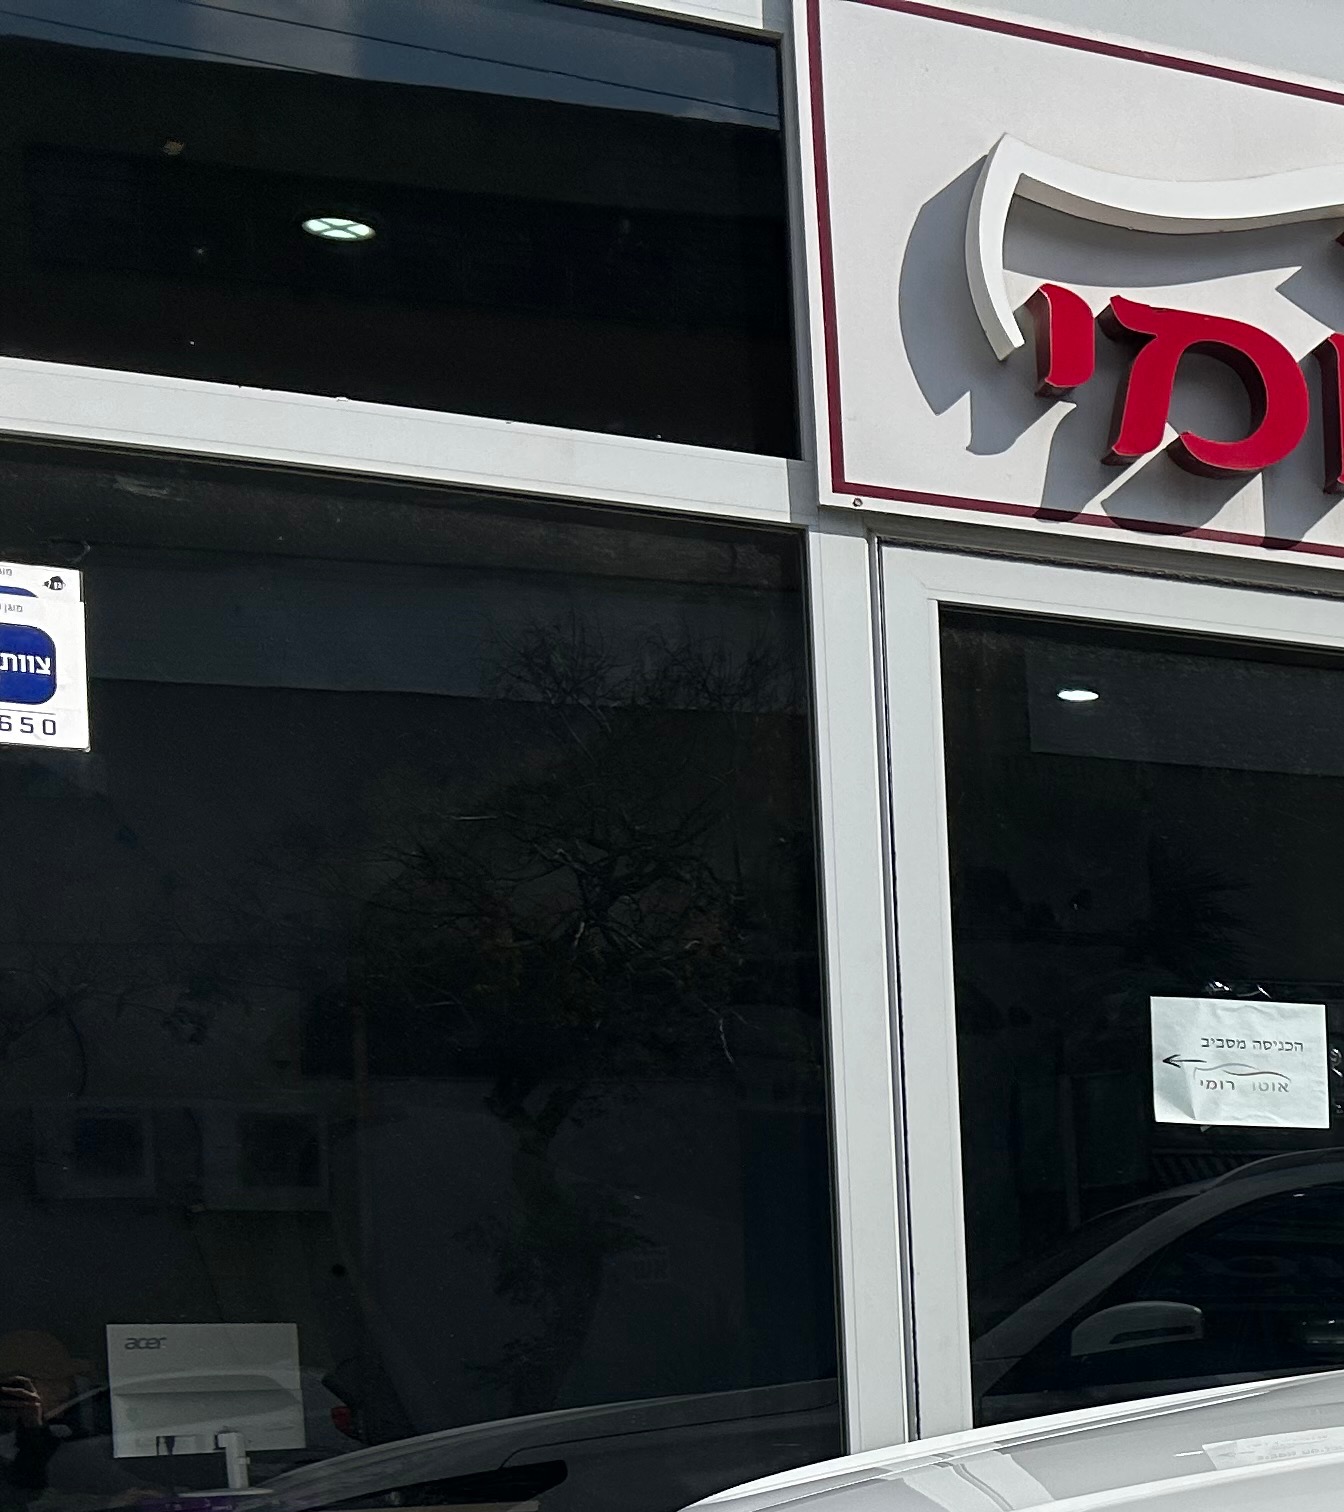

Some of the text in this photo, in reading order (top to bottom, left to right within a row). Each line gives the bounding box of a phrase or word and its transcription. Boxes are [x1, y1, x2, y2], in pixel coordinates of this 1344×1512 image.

[1201, 1037, 1304, 1052] הכניסה מסביב
[1200, 1079, 1289, 1093] אוטו רומי
[124, 1337, 167, 1350] acer
